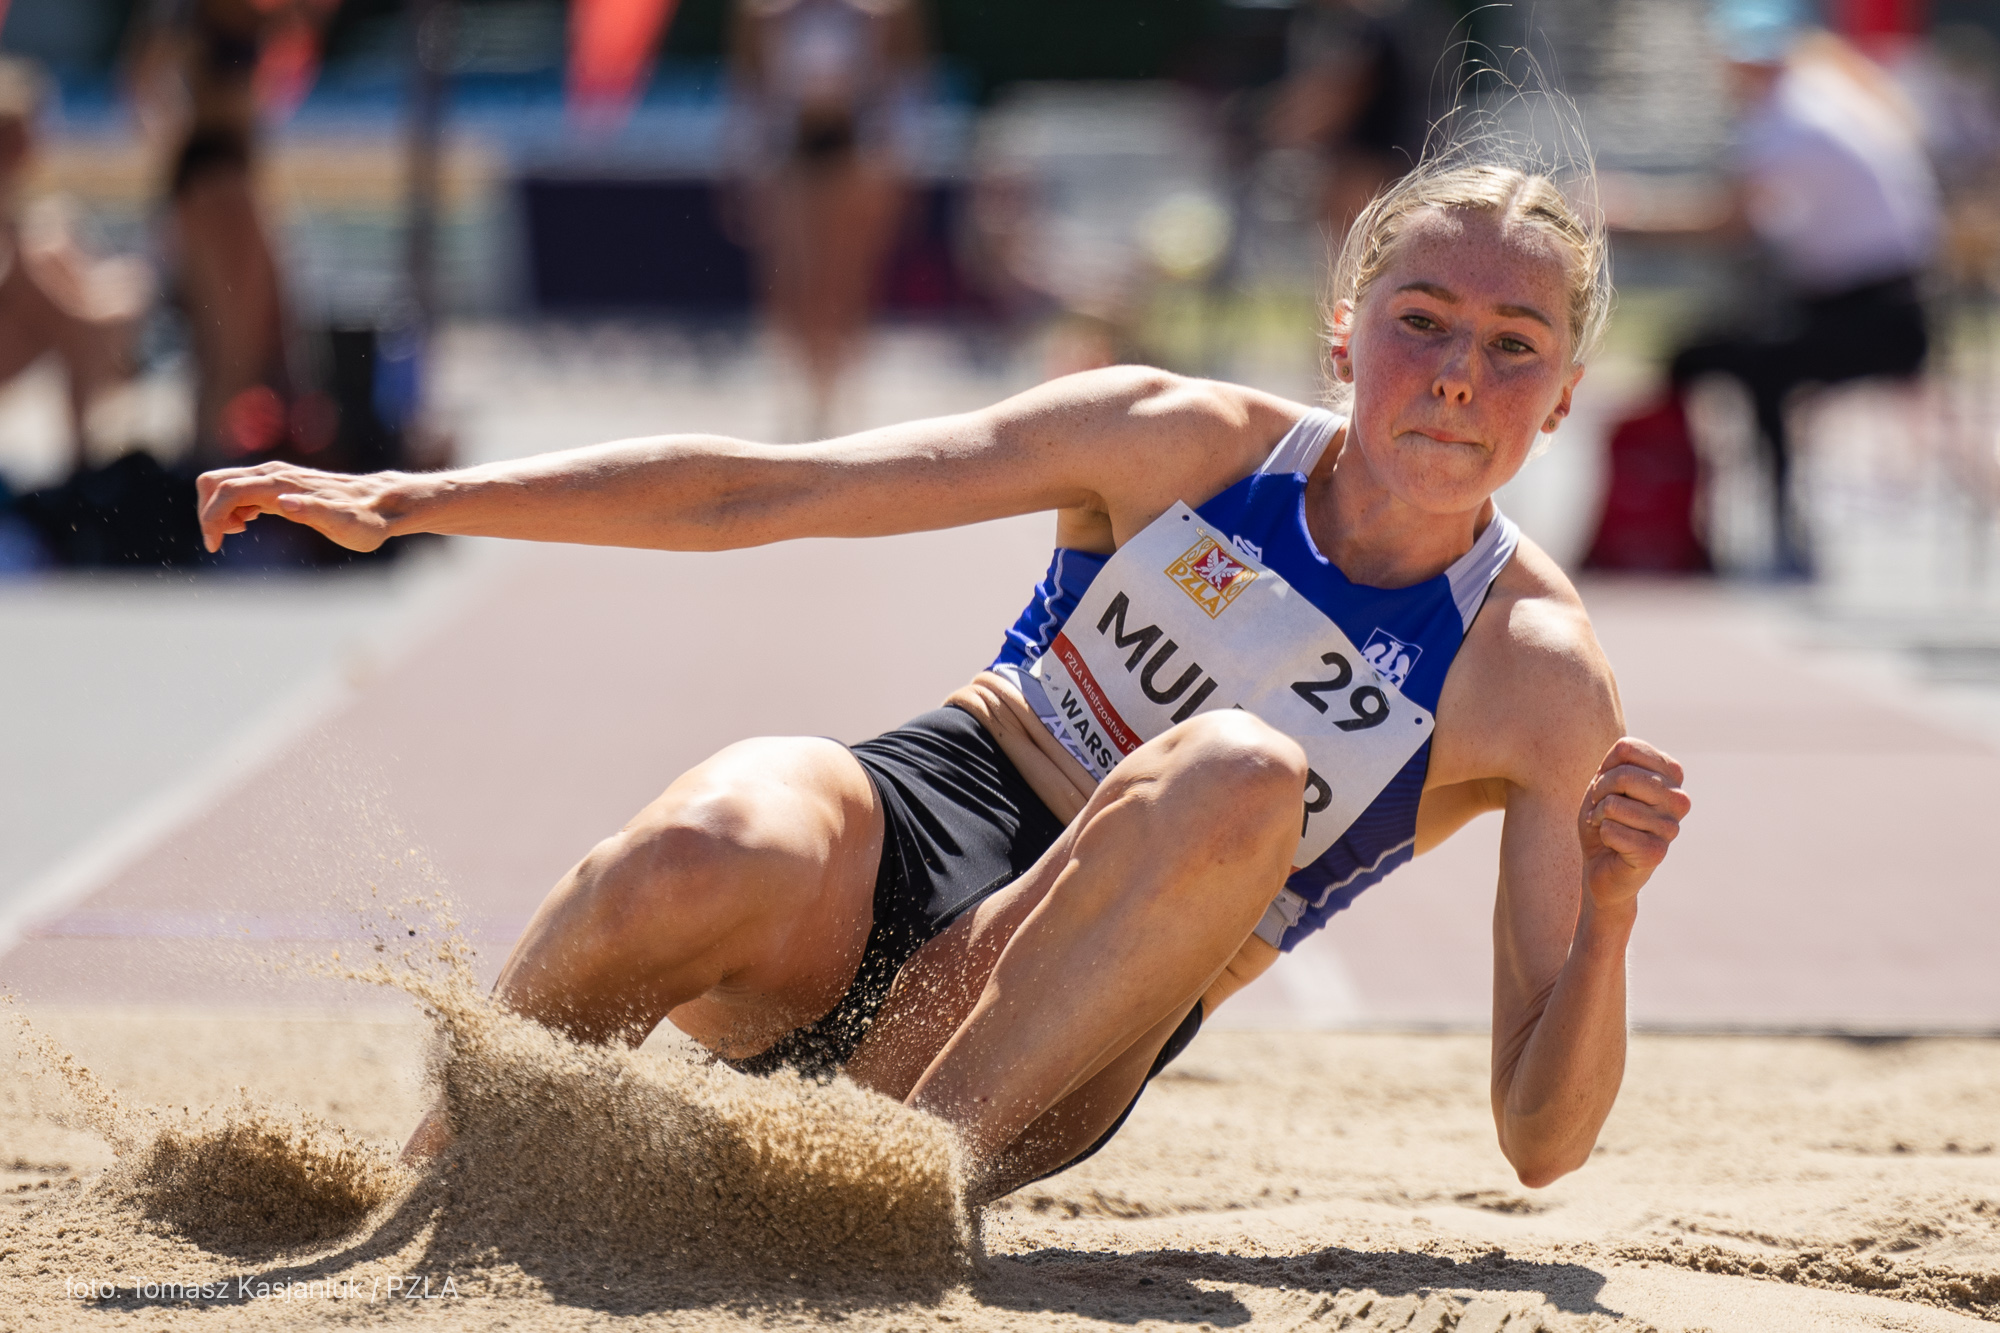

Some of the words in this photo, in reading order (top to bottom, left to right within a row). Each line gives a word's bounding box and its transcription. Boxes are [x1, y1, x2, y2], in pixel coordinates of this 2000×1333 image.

[1169, 561, 1221, 614] PZLA
[1064, 651, 1083, 680] PZLA
[1082, 678, 1128, 746] Mistrzostwa
[1290, 651, 1391, 732] 29
